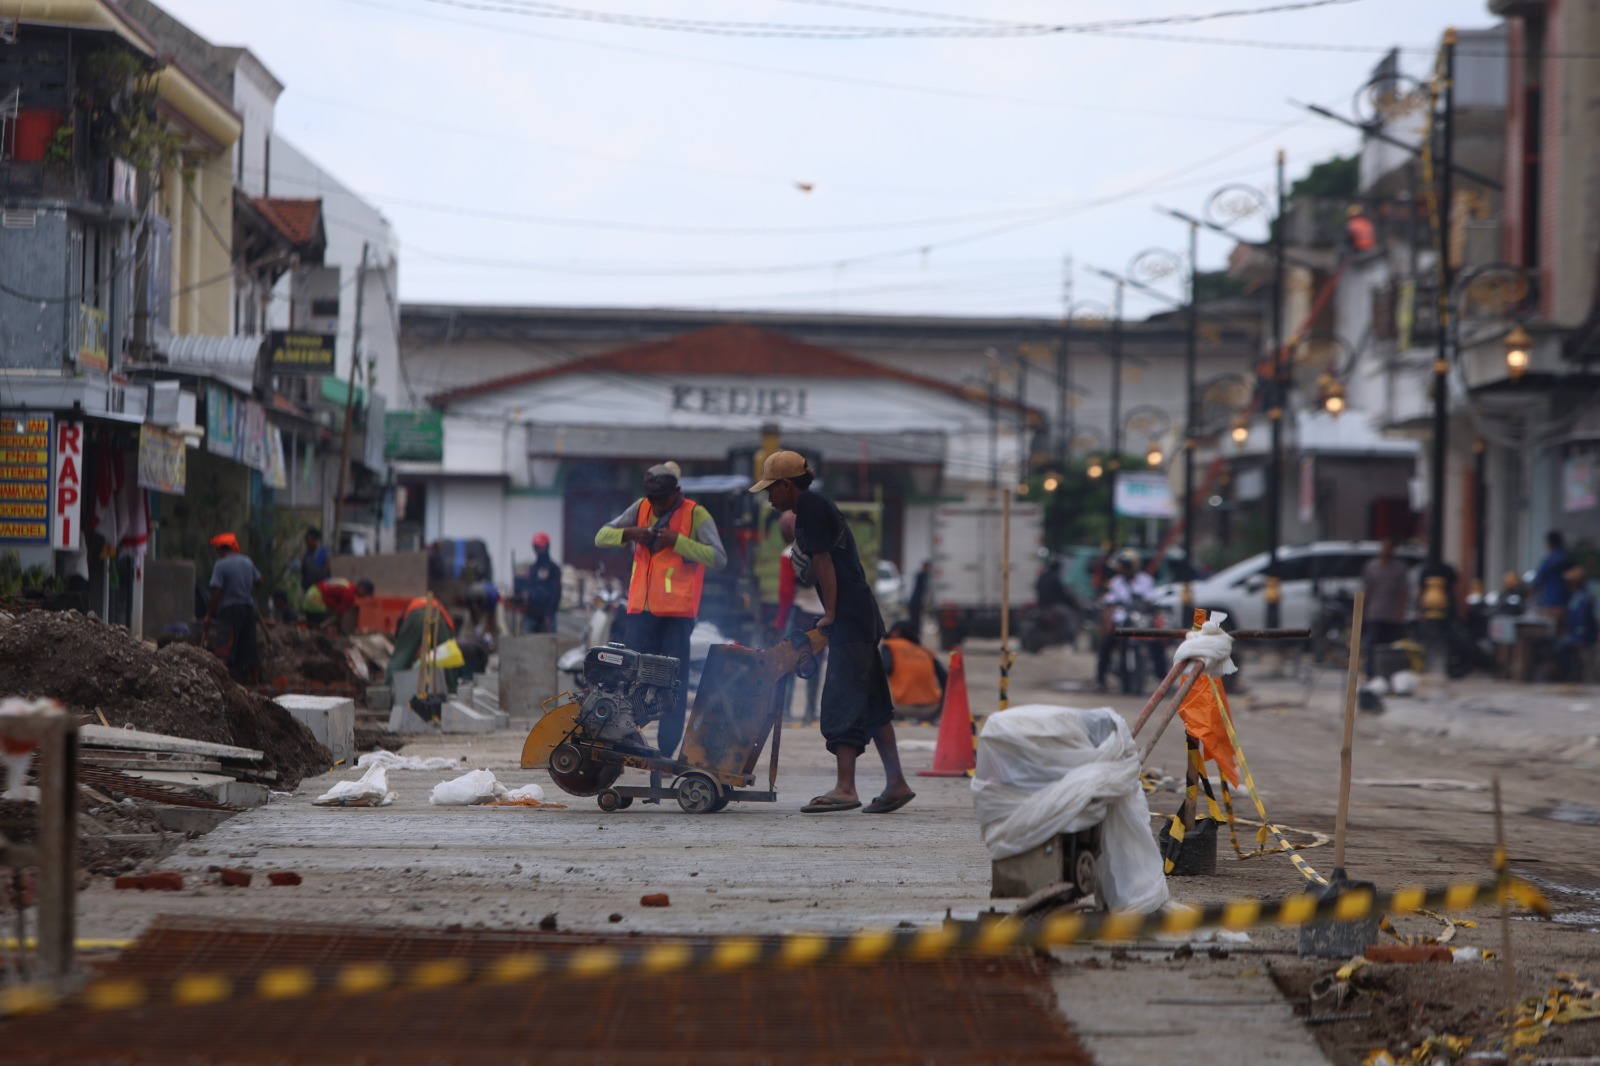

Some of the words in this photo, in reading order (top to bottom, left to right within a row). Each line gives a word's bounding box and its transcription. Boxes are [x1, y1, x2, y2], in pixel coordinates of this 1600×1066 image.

[671, 385, 808, 416] KEDIRI
[5, 451, 38, 464] PNS
[22, 483, 45, 499] DADA
[57, 424, 80, 548] RAPI
